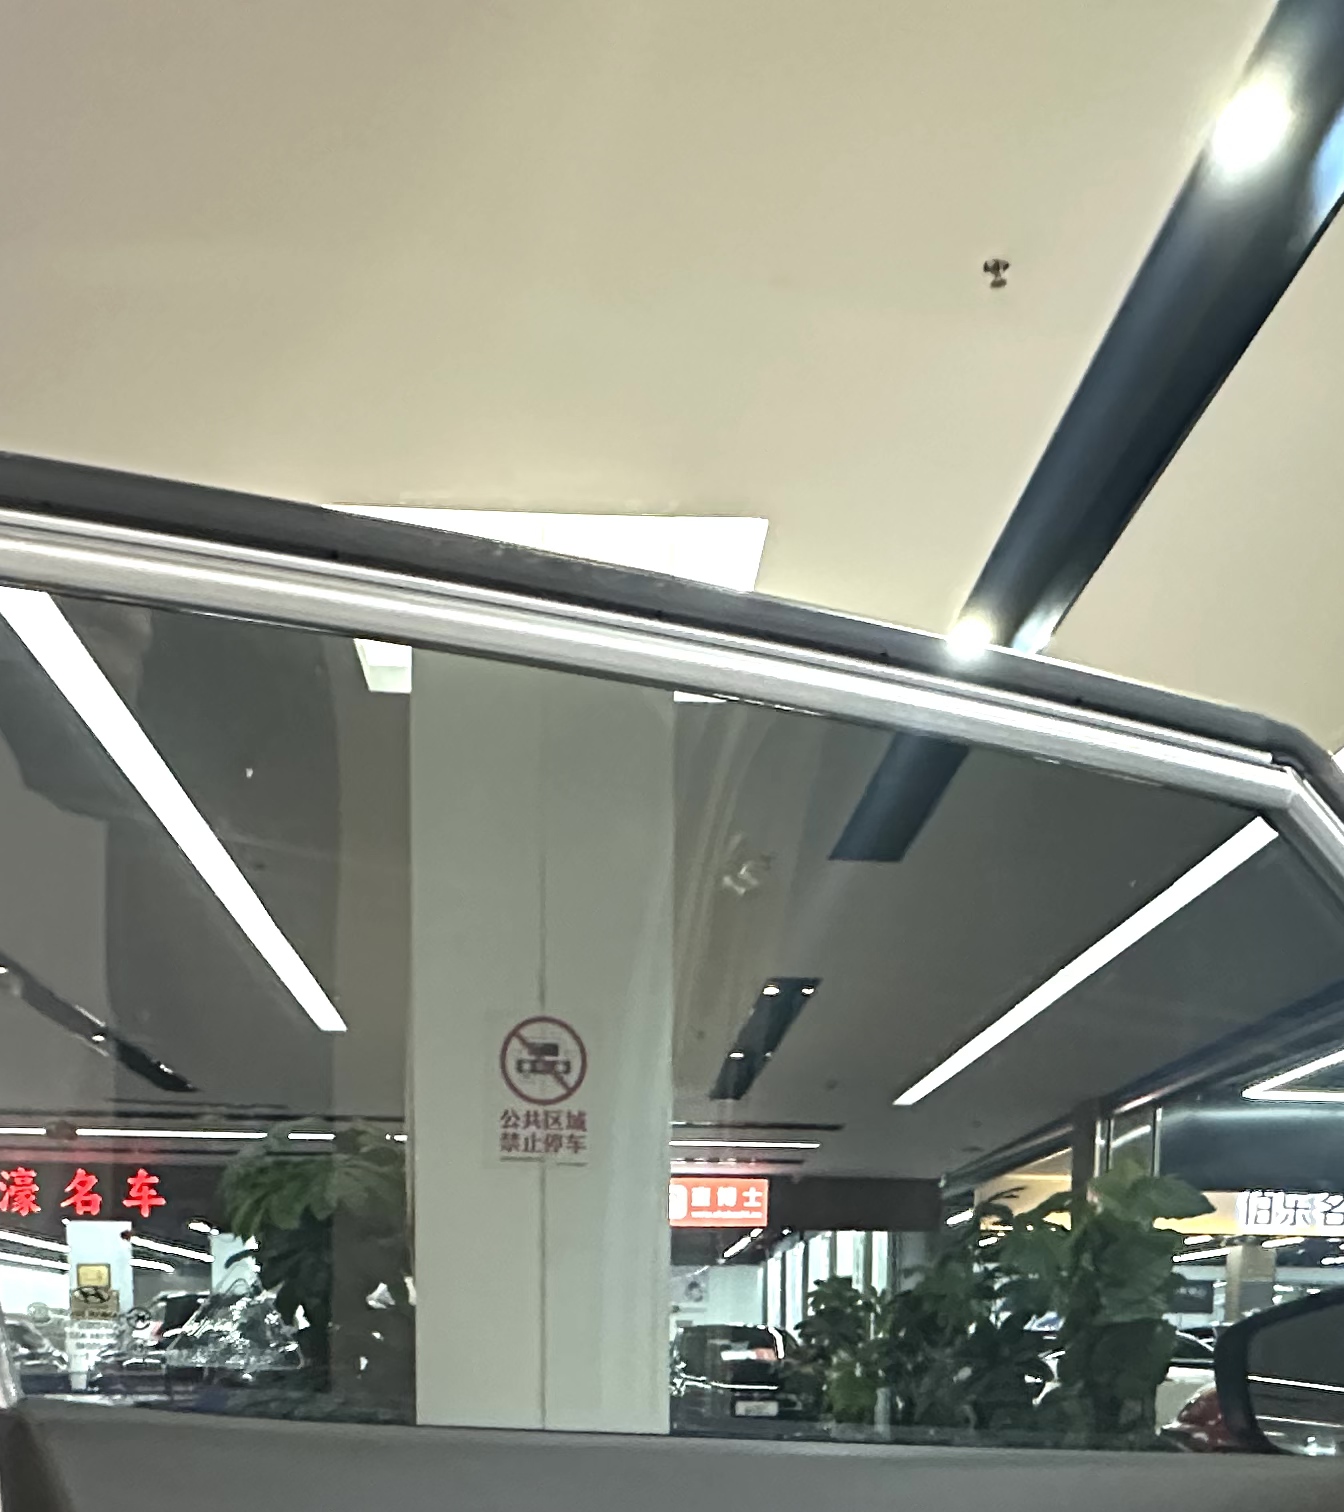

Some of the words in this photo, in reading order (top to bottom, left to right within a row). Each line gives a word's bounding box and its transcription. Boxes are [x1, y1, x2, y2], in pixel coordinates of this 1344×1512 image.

[500, 1108, 587, 1132] 公共区域
[500, 1132, 587, 1154] 禁止停车
